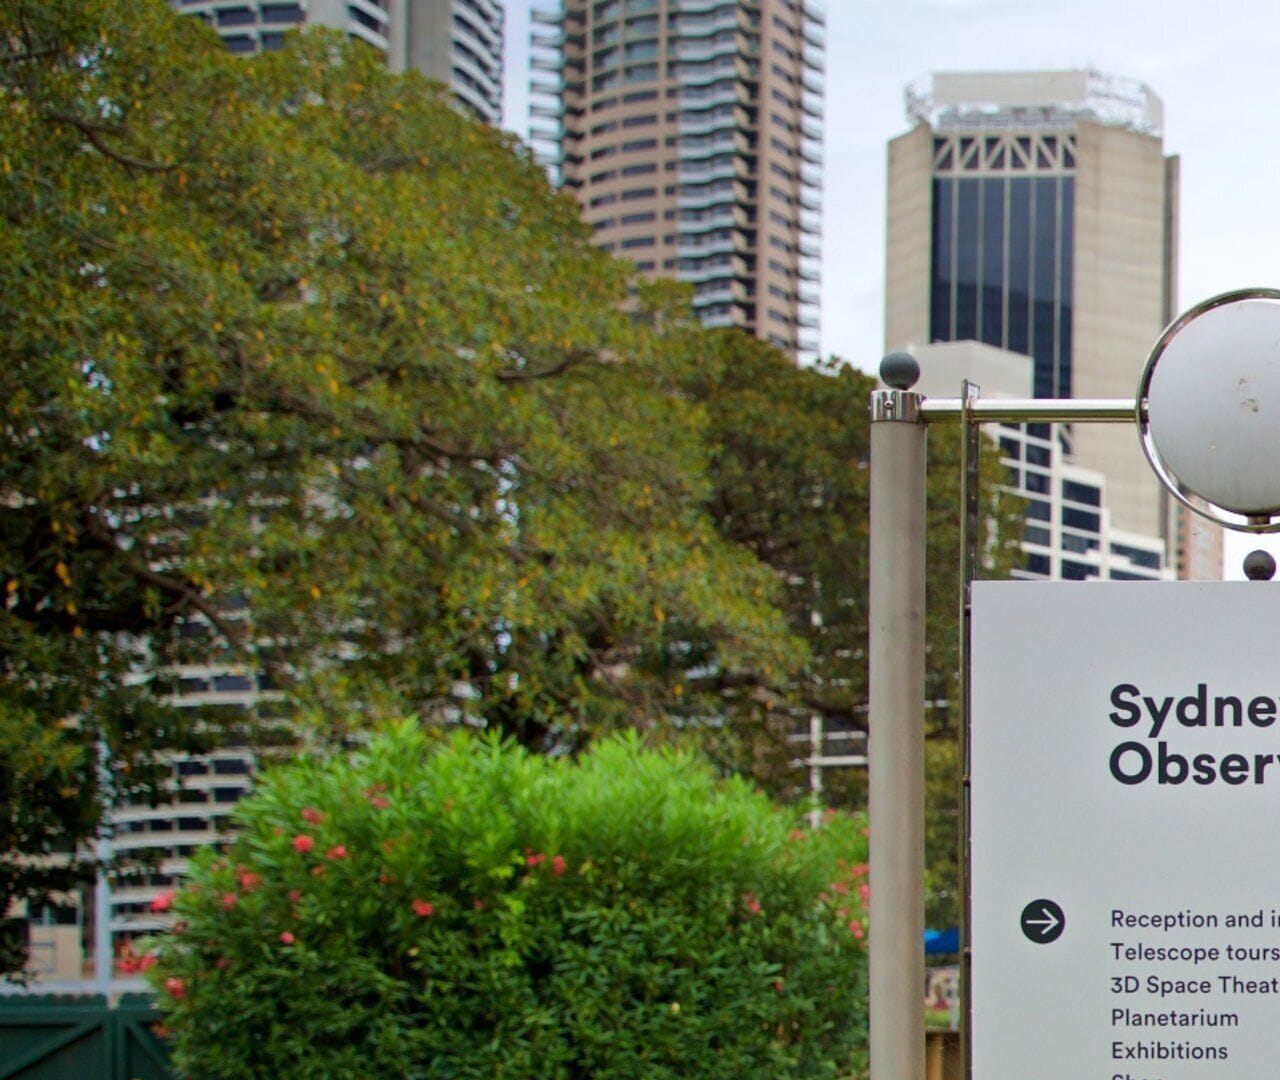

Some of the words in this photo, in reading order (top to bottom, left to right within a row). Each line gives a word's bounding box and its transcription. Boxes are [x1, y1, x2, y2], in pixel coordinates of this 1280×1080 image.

[1111, 909, 1218, 932] Reception
[1225, 909, 1264, 928] and
[1110, 942, 1220, 965] Telescope
[1225, 944, 1280, 962] tours
[1110, 975, 1140, 994] 3D
[1146, 975, 1212, 998] Space
[1111, 1008, 1239, 1027] Planetarium
[1111, 1041, 1228, 1060] Exhibitions
